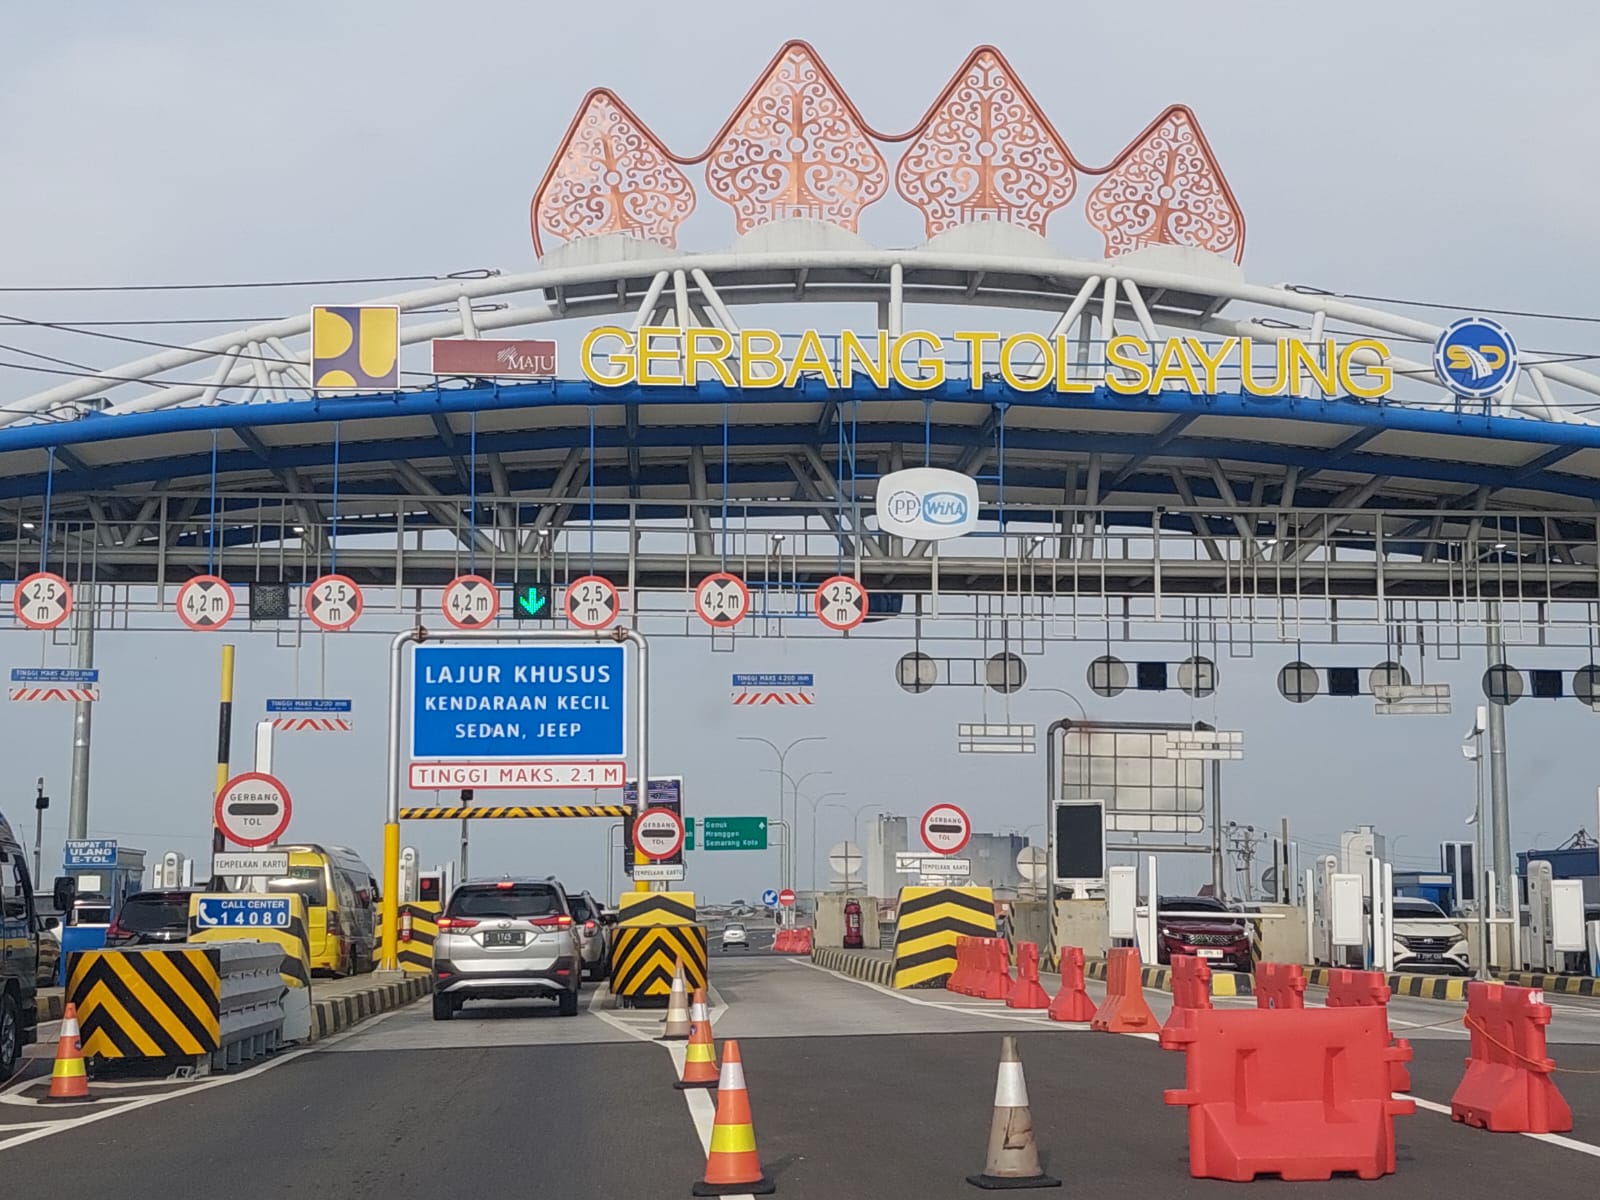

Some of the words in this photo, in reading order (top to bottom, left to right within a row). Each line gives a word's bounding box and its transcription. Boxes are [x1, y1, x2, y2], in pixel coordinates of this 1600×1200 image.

[507, 355, 555, 374] MAJU
[580, 325, 946, 392] GERBANG
[953, 331, 1095, 393] TOL
[1104, 333, 1395, 399] SAYUNG
[895, 499, 917, 515] PP
[33, 583, 55, 602] 2,5
[324, 584, 346, 602] 2,5
[582, 586, 603, 604] 2,5
[832, 586, 853, 604] 2,5
[186, 594, 207, 614] 4,2
[212, 597, 224, 613] m
[452, 594, 472, 614] 4,2
[476, 596, 488, 611] m
[705, 592, 724, 611] 4,2
[728, 594, 739, 608] m
[37, 607, 49, 620] m
[329, 607, 341, 621] m
[587, 607, 599, 621] m
[837, 608, 848, 621] m
[425, 665, 501, 684] LAJUR
[514, 665, 610, 683] KHUSUS
[425, 696, 547, 711] KENDARAAN
[557, 695, 610, 710] KECIL
[455, 723, 526, 739] SEDAN,
[537, 723, 581, 737] JEEP
[419, 768, 488, 783] TINGGI
[499, 768, 560, 782] MAKS.
[571, 768, 594, 782] 2.1
[604, 768, 618, 782] M
[230, 793, 279, 801] GERBANG
[243, 818, 262, 826] TOL
[705, 839, 740, 847] Semarang
[216, 860, 258, 868] TEMPELKAN
[262, 860, 287, 868] KARTU
[221, 901, 246, 909] CALL
[248, 901, 285, 909] CENTER
